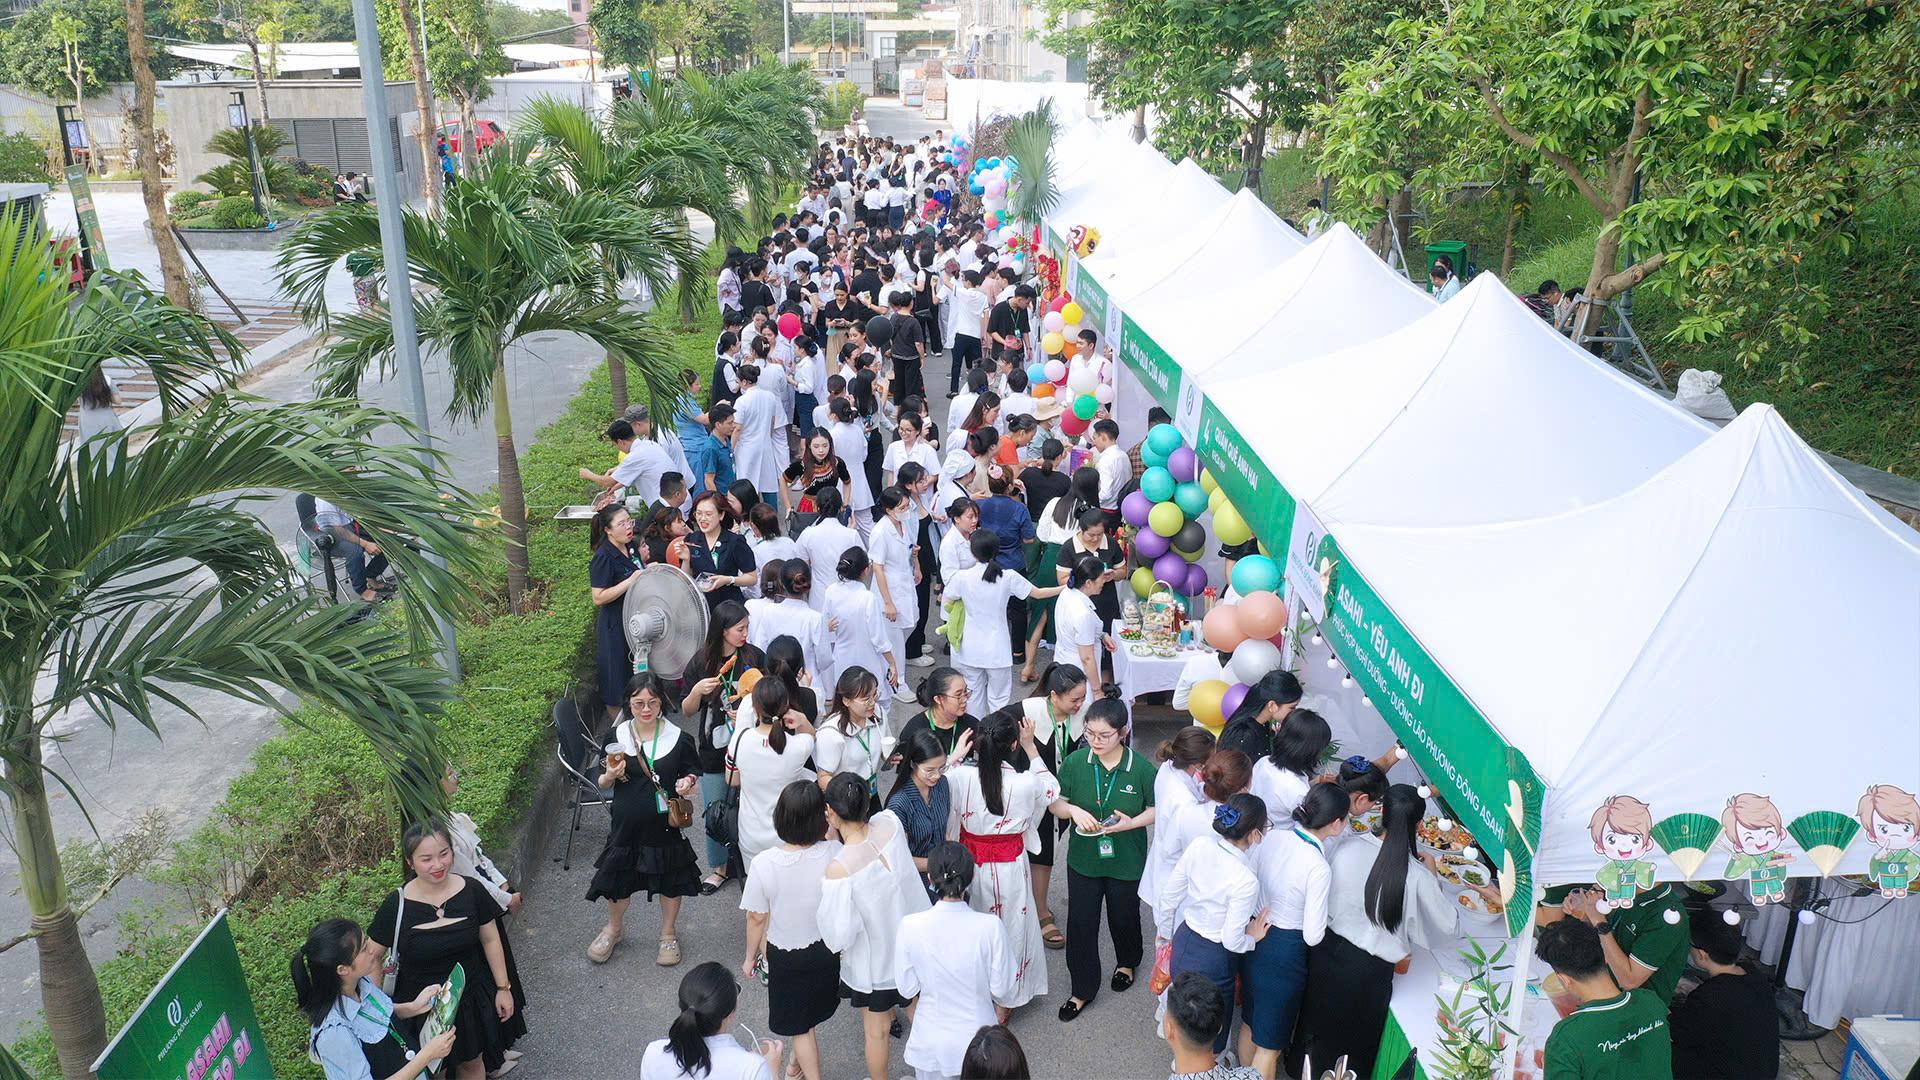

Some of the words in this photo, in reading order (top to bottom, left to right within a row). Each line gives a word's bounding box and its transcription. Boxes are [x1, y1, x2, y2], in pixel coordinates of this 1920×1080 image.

[1203, 418, 1210, 446] 4
[1236, 454, 1249, 479] ANH
[1247, 465, 1258, 491] HAI
[1337, 583, 1363, 629] ASAHI
[1370, 620, 1388, 659] YÊU
[1387, 647, 1411, 689] ANH
[1410, 673, 1424, 706] ĐI
[1412, 719, 1426, 743] LÃO
[1456, 774, 1480, 811] ĐÔNG
[1479, 804, 1505, 843] ASAHI
[185, 1011, 232, 1080] ASAHI
